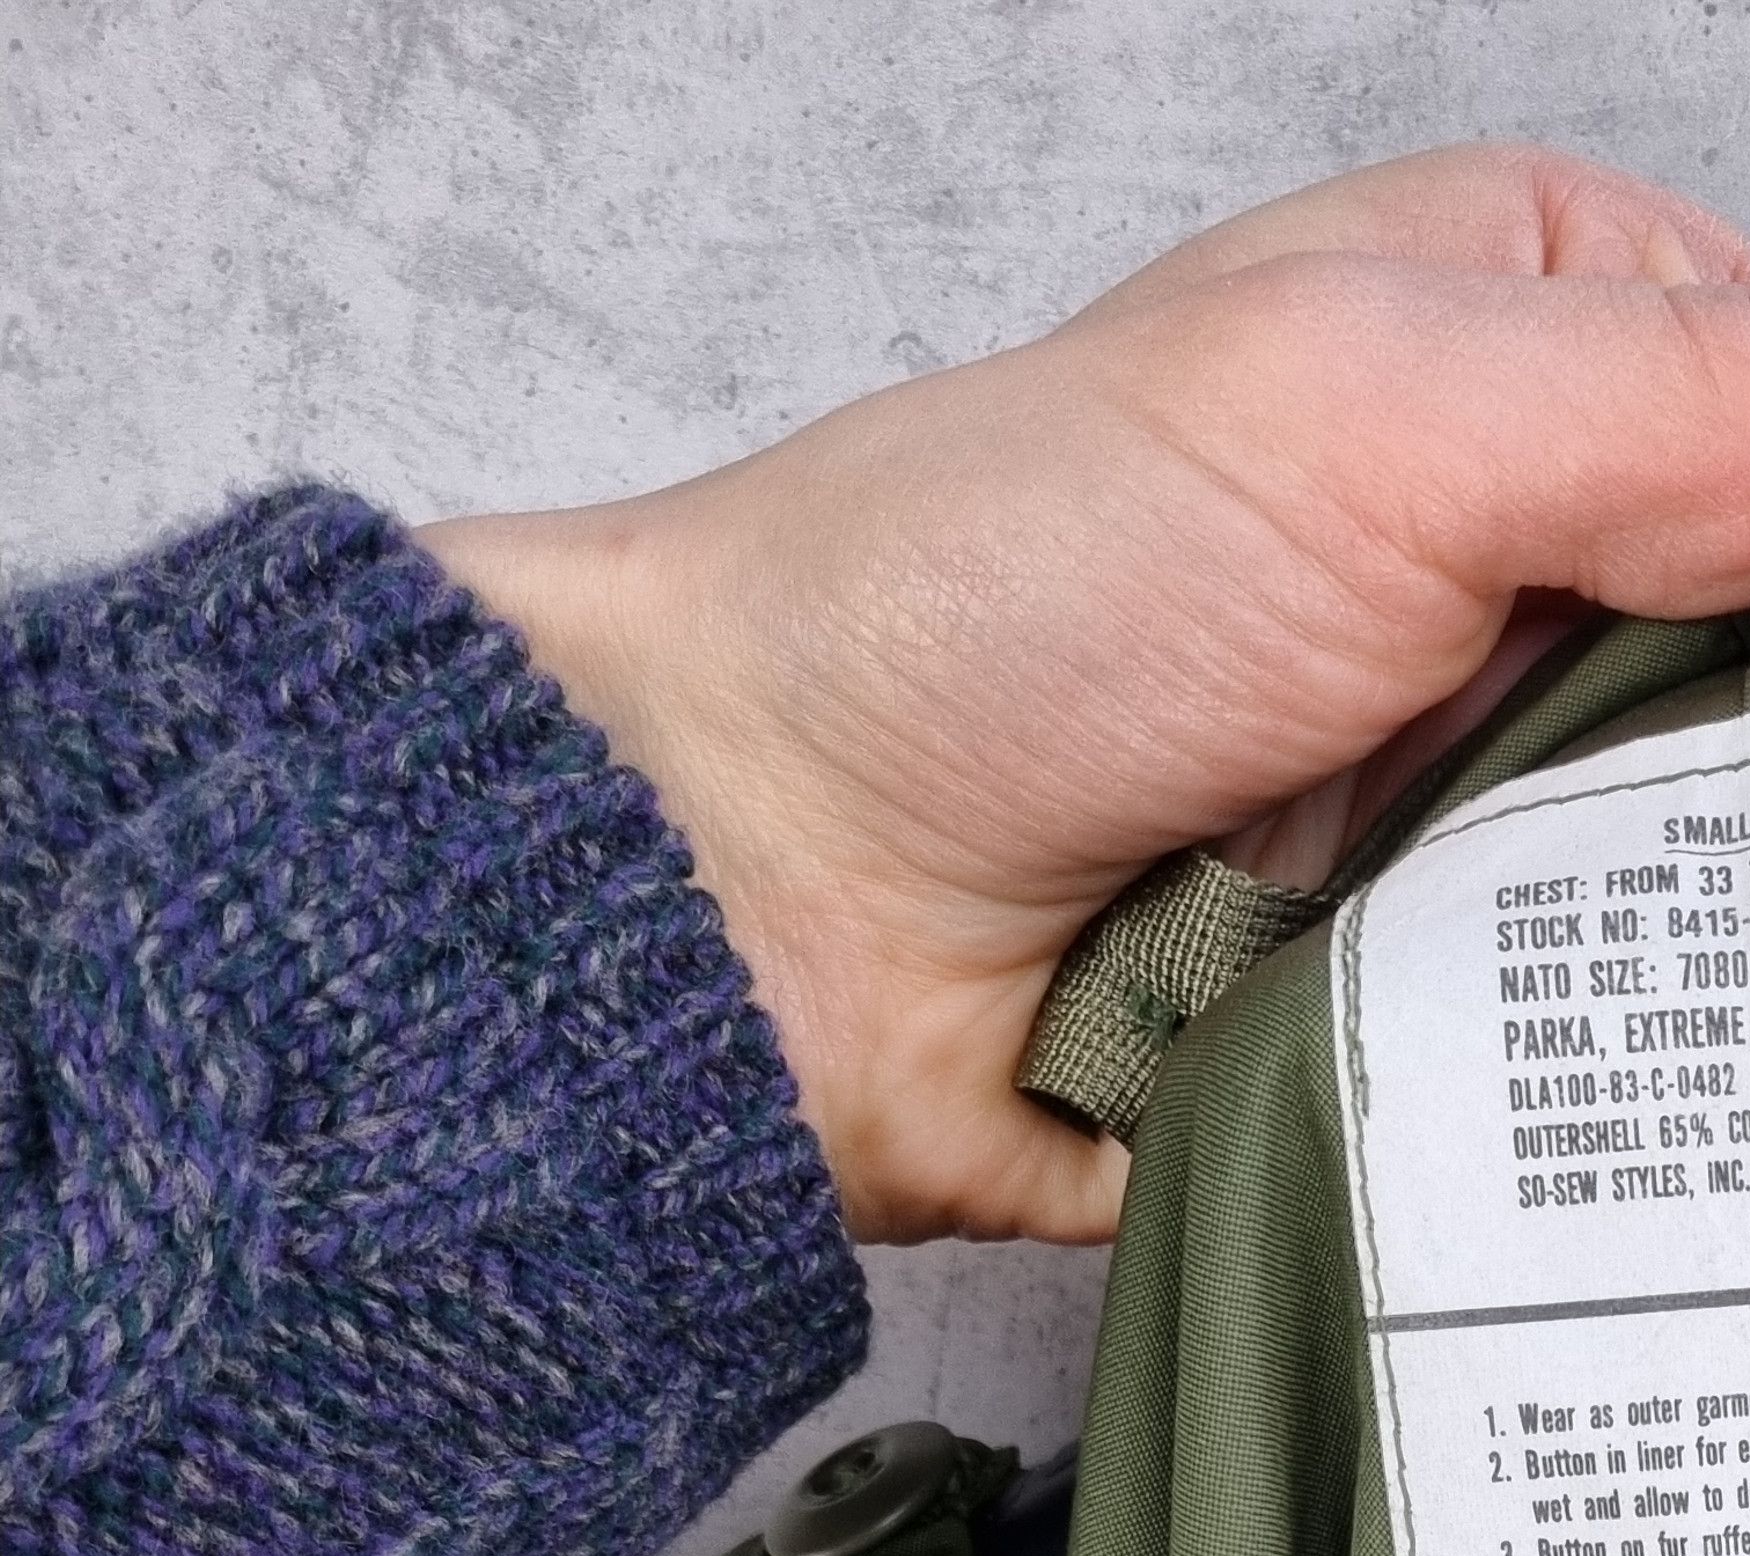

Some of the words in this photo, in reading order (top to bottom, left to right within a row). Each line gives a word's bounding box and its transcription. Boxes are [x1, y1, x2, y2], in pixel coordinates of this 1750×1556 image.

[1495, 875, 1588, 911] CHEST:
[1605, 863, 1679, 898] FROM
[1698, 865, 1733, 897] 33
[1496, 912, 1584, 953] STOCK
[1601, 908, 1649, 945] NO:
[1499, 962, 1571, 1004] NATO
[1588, 956, 1658, 998] SIZE:
[1503, 1015, 1606, 1062] PARKA,
[1624, 1006, 1746, 1054] EXTREME
[1508, 1062, 1737, 1112] DLA100-83-C-0482
[1512, 1117, 1646, 1161] OUTERSHELL
[1659, 1112, 1714, 1149] 65%
[1517, 1170, 1598, 1210] SO-SEW
[1611, 1162, 1695, 1203] STYLES,
[1483, 1405, 1507, 1438] 1.
[1517, 1402, 1576, 1435] Wear
[1589, 1403, 1614, 1430] as
[1627, 1395, 1683, 1427] outer
[1531, 1493, 1573, 1525] wet
[1584, 1488, 1622, 1521] and
[1633, 1486, 1690, 1518] allow
[1702, 1484, 1724, 1512] to
